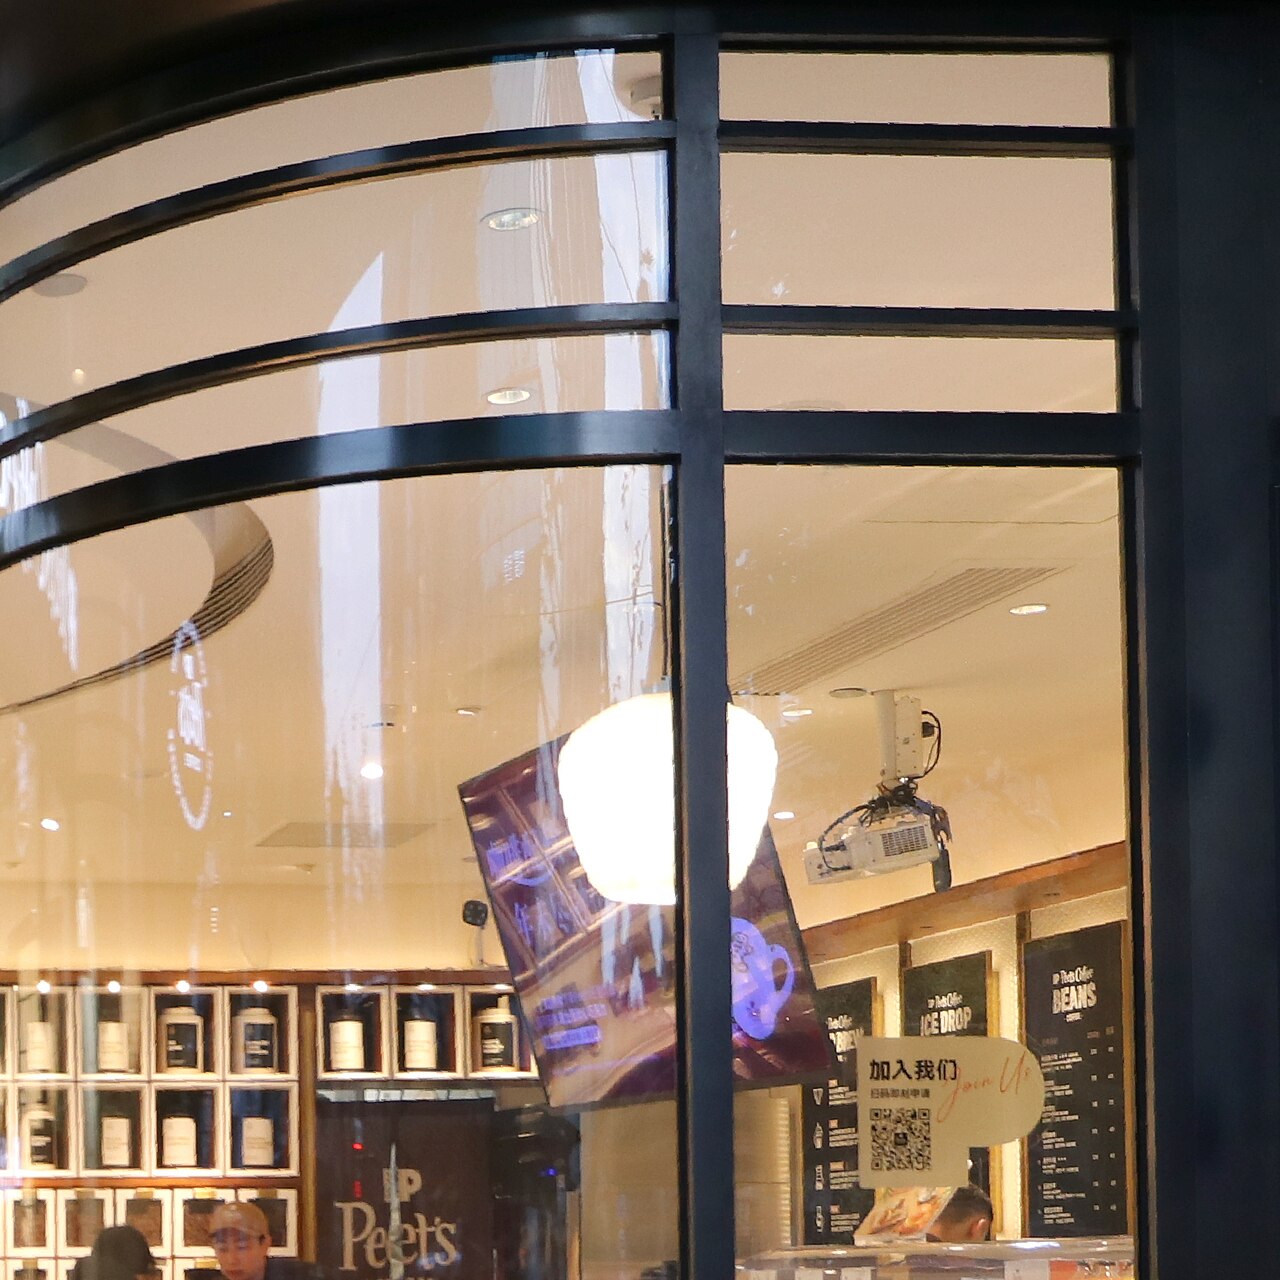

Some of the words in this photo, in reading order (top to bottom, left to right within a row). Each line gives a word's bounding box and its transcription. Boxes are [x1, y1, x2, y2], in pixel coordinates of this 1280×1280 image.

[1051, 981, 1098, 1015] BEANS
[920, 1011, 940, 1037] ICE
[939, 1006, 972, 1035] DROP
[869, 1058, 958, 1081] 加入我们
[333, 1201, 458, 1271] Peet's
